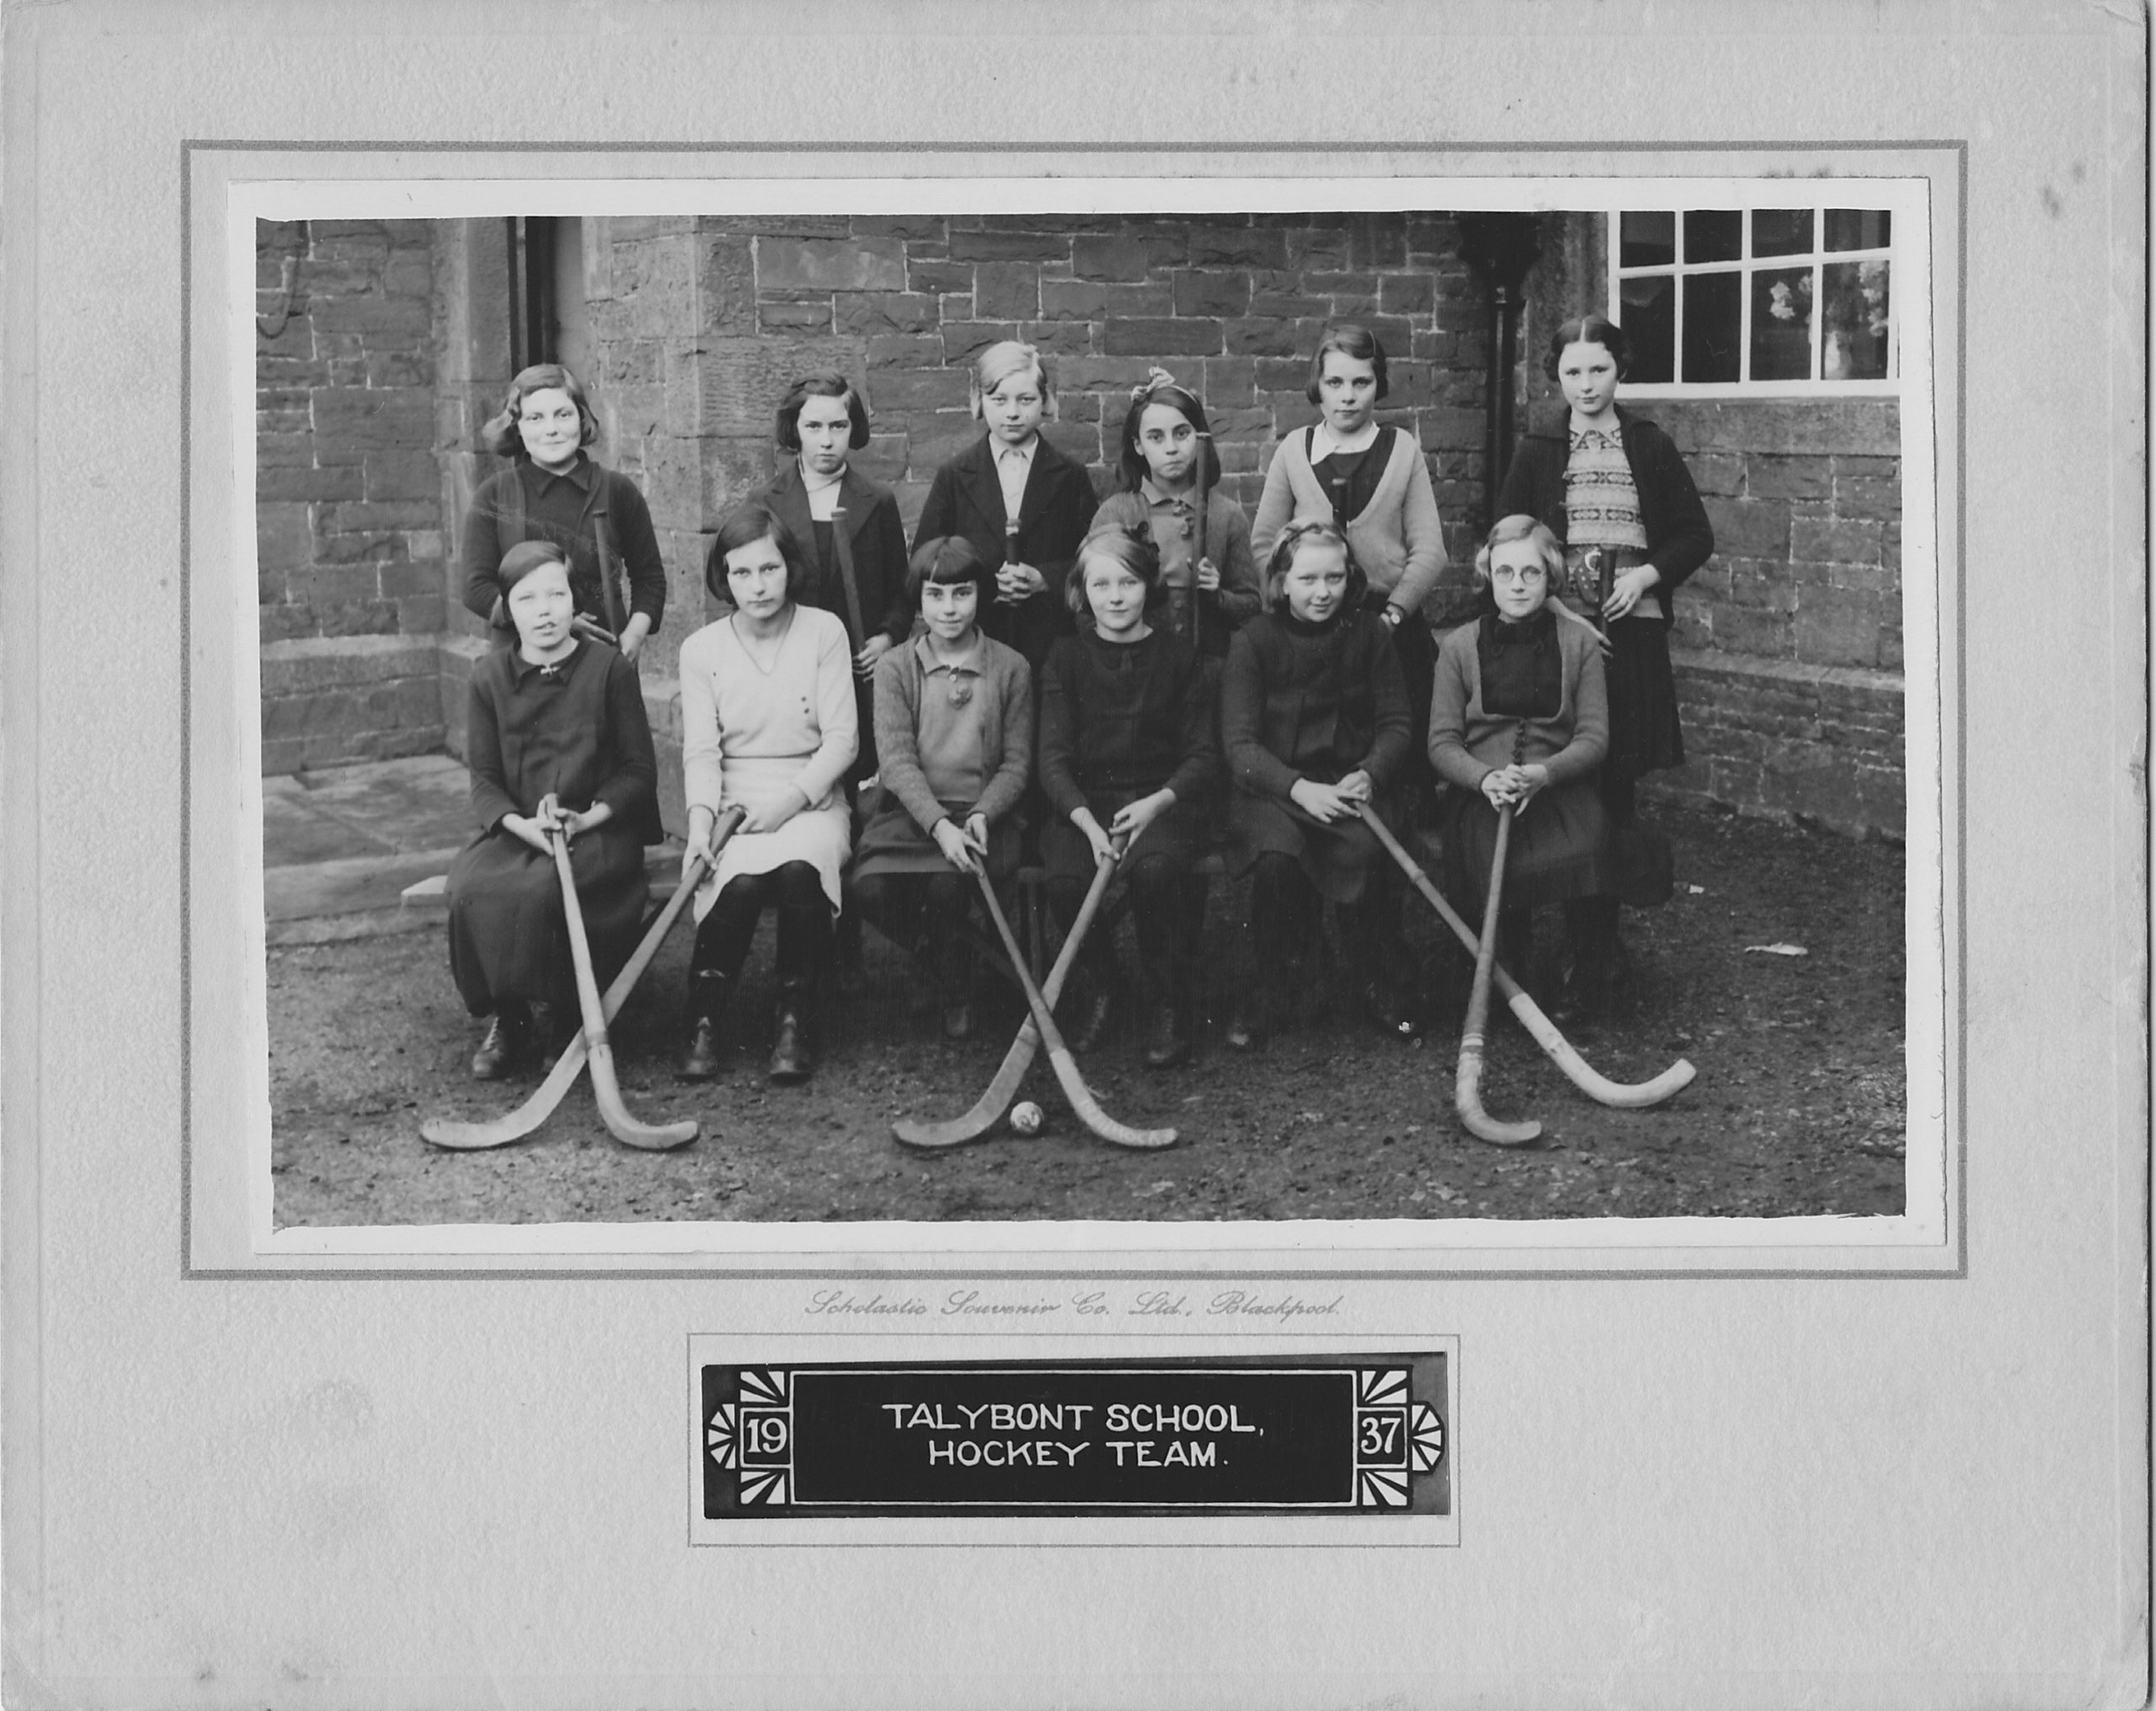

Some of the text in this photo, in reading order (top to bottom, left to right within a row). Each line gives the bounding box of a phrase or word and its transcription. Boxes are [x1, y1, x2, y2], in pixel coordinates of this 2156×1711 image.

[804, 1290, 927, 1316] Scholastic
[940, 1290, 1061, 1316] Souvenir
[1073, 1292, 1108, 1316] Co.
[882, 1404, 1265, 1435] TALYBONT SCHOOL,
[747, 1418, 787, 1453] 19
[1360, 1417, 1401, 1454] 37
[929, 1440, 1229, 1467] HOCKEY TEAM.
